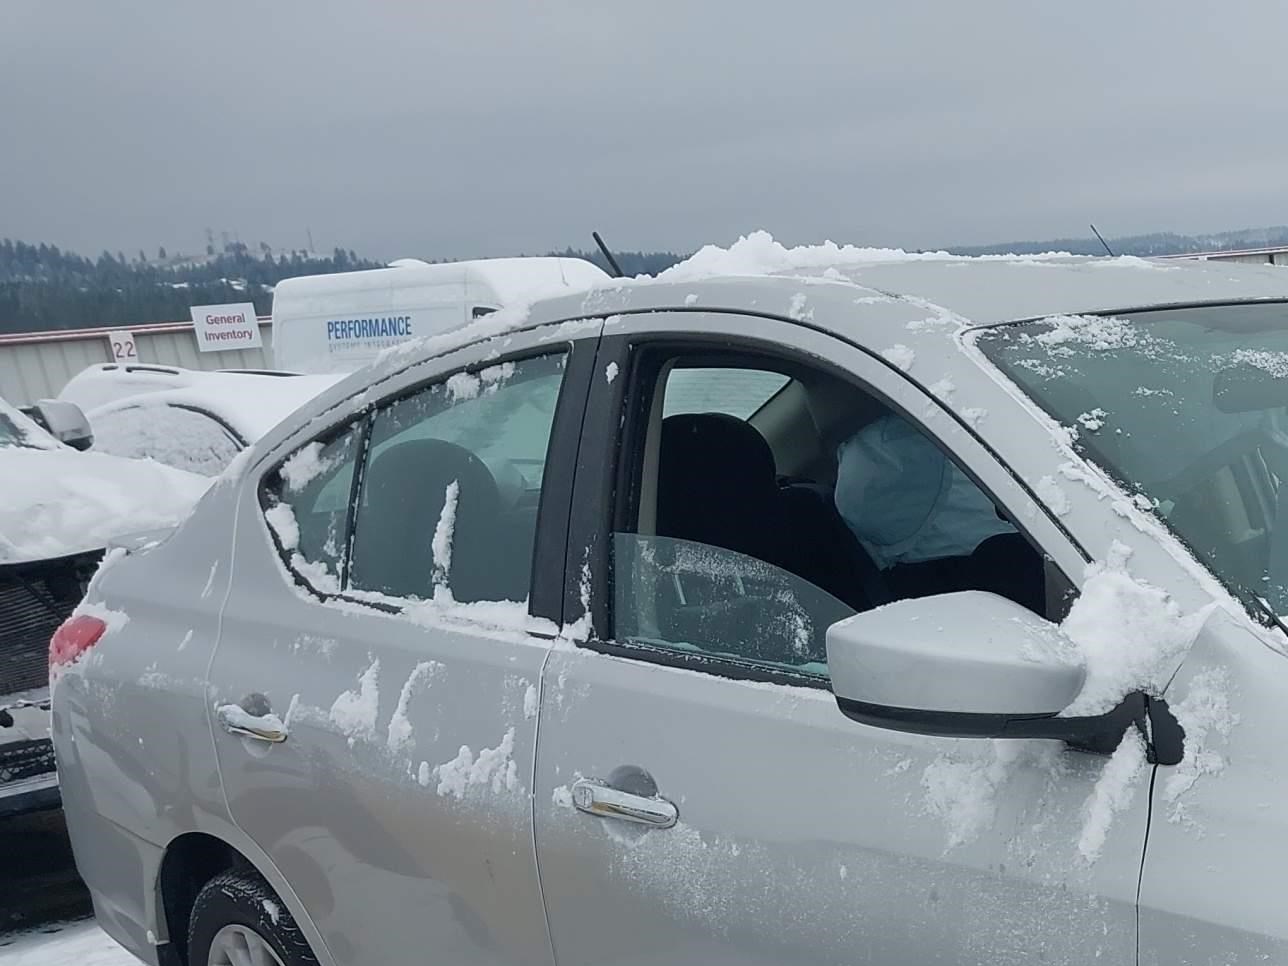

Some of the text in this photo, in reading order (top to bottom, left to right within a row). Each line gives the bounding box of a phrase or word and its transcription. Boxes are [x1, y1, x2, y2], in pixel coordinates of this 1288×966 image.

[206, 312, 246, 325] General
[204, 328, 253, 342] Inventory
[327, 316, 412, 340] PERFORMANCE
[113, 341, 137, 359] 22
